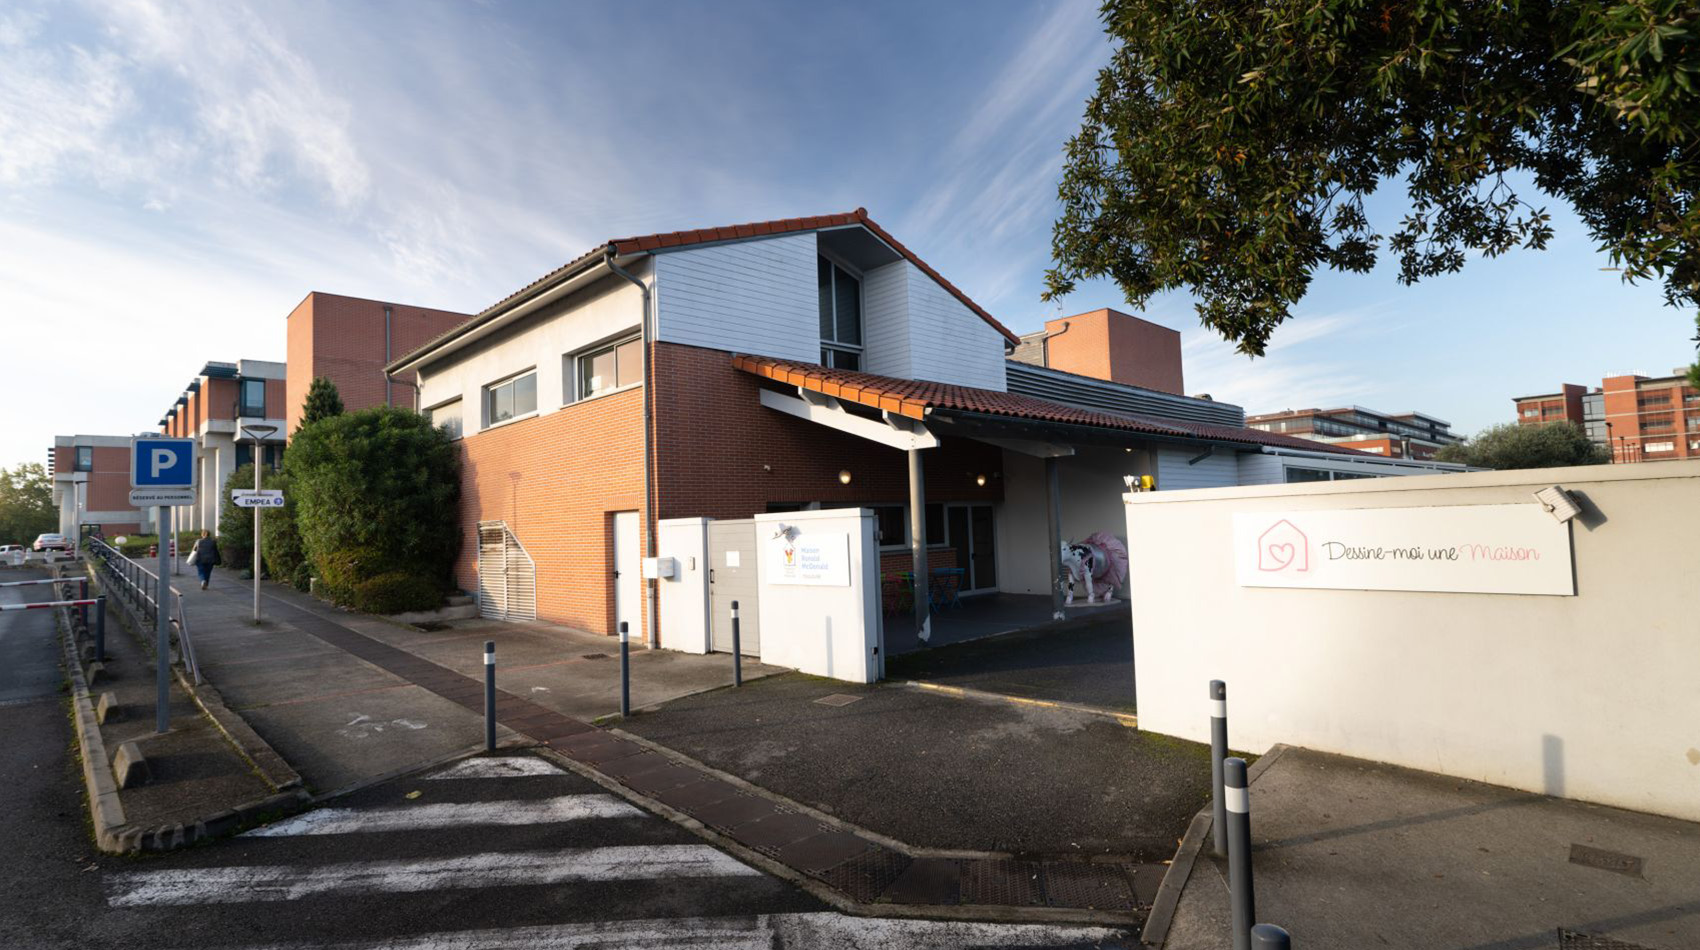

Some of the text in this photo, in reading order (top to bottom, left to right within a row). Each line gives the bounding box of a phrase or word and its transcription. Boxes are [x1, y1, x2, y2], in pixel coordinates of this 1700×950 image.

[151, 448, 177, 478] P
[1321, 541, 1540, 561] Dessine-moi une Maison
